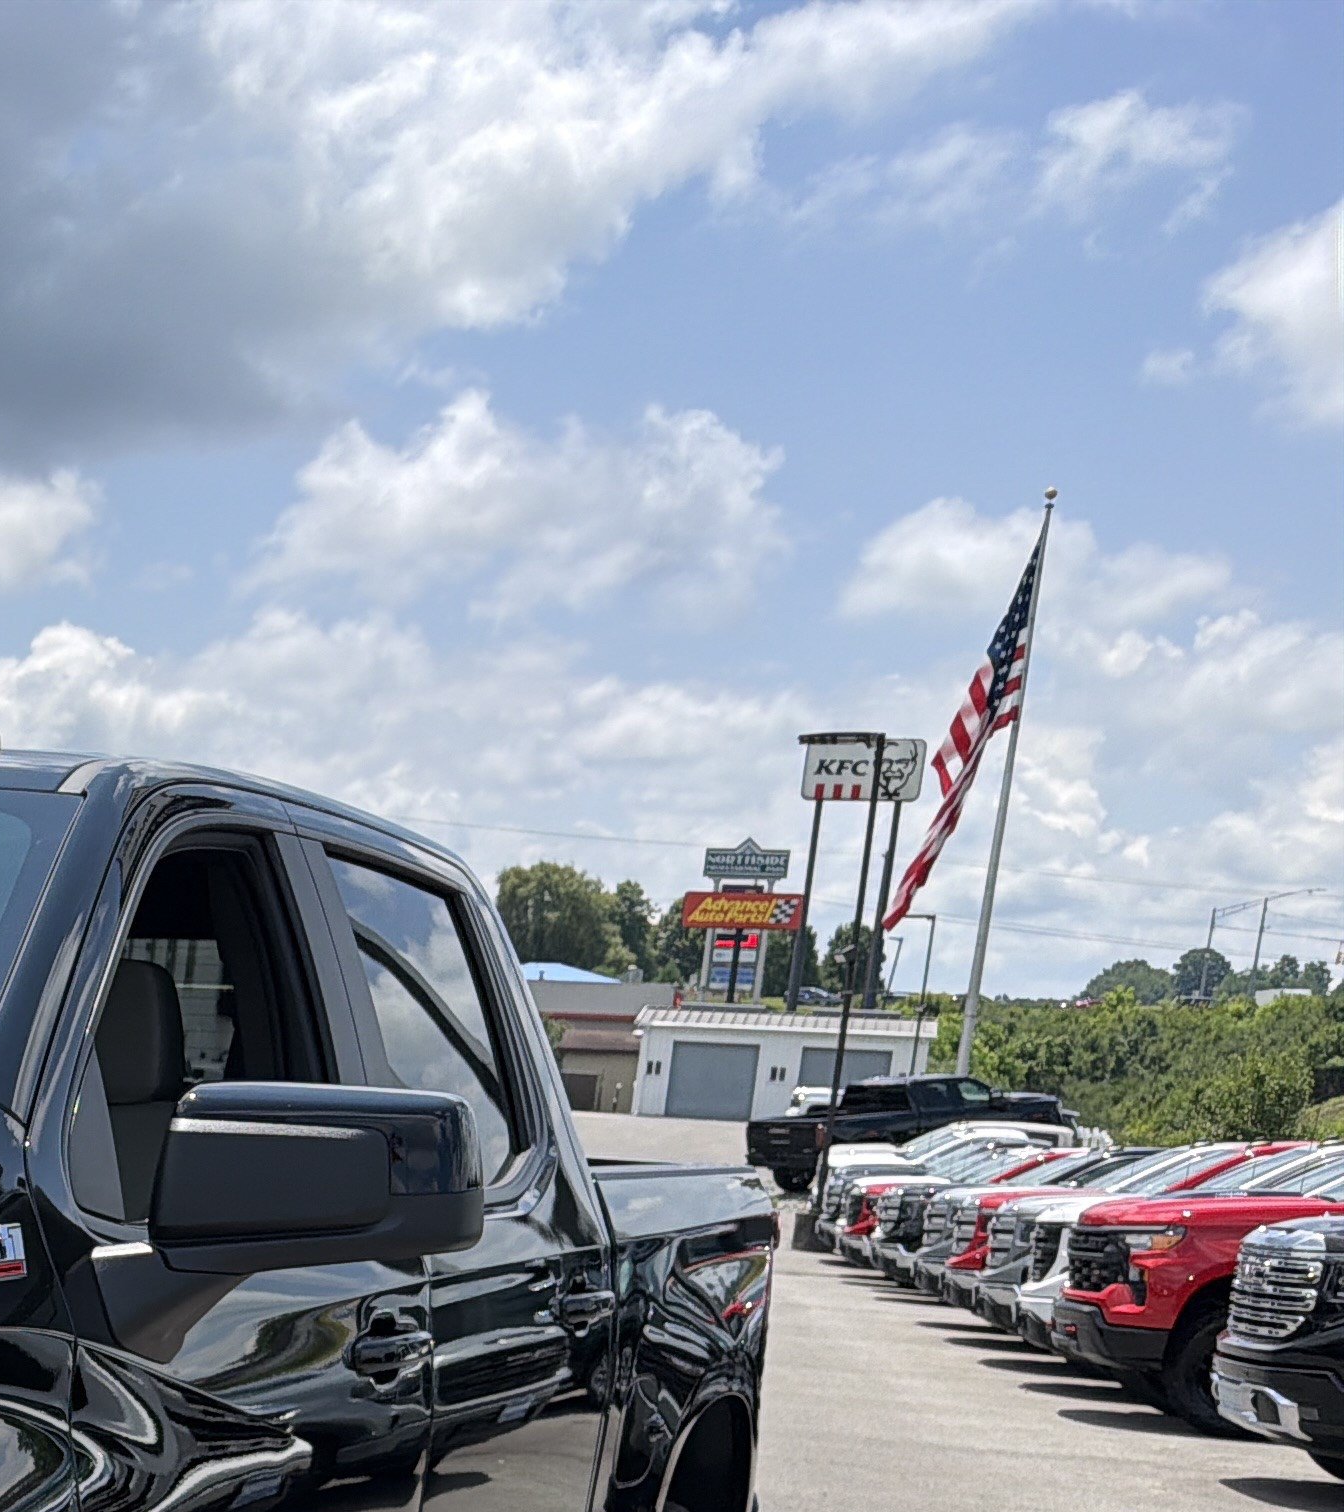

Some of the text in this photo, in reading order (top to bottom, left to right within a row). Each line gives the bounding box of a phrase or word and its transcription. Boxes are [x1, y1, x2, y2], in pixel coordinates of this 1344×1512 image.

[814, 758, 870, 777] KFC
[698, 896, 770, 912] Advance
[687, 907, 765, 924] Auto Parts
